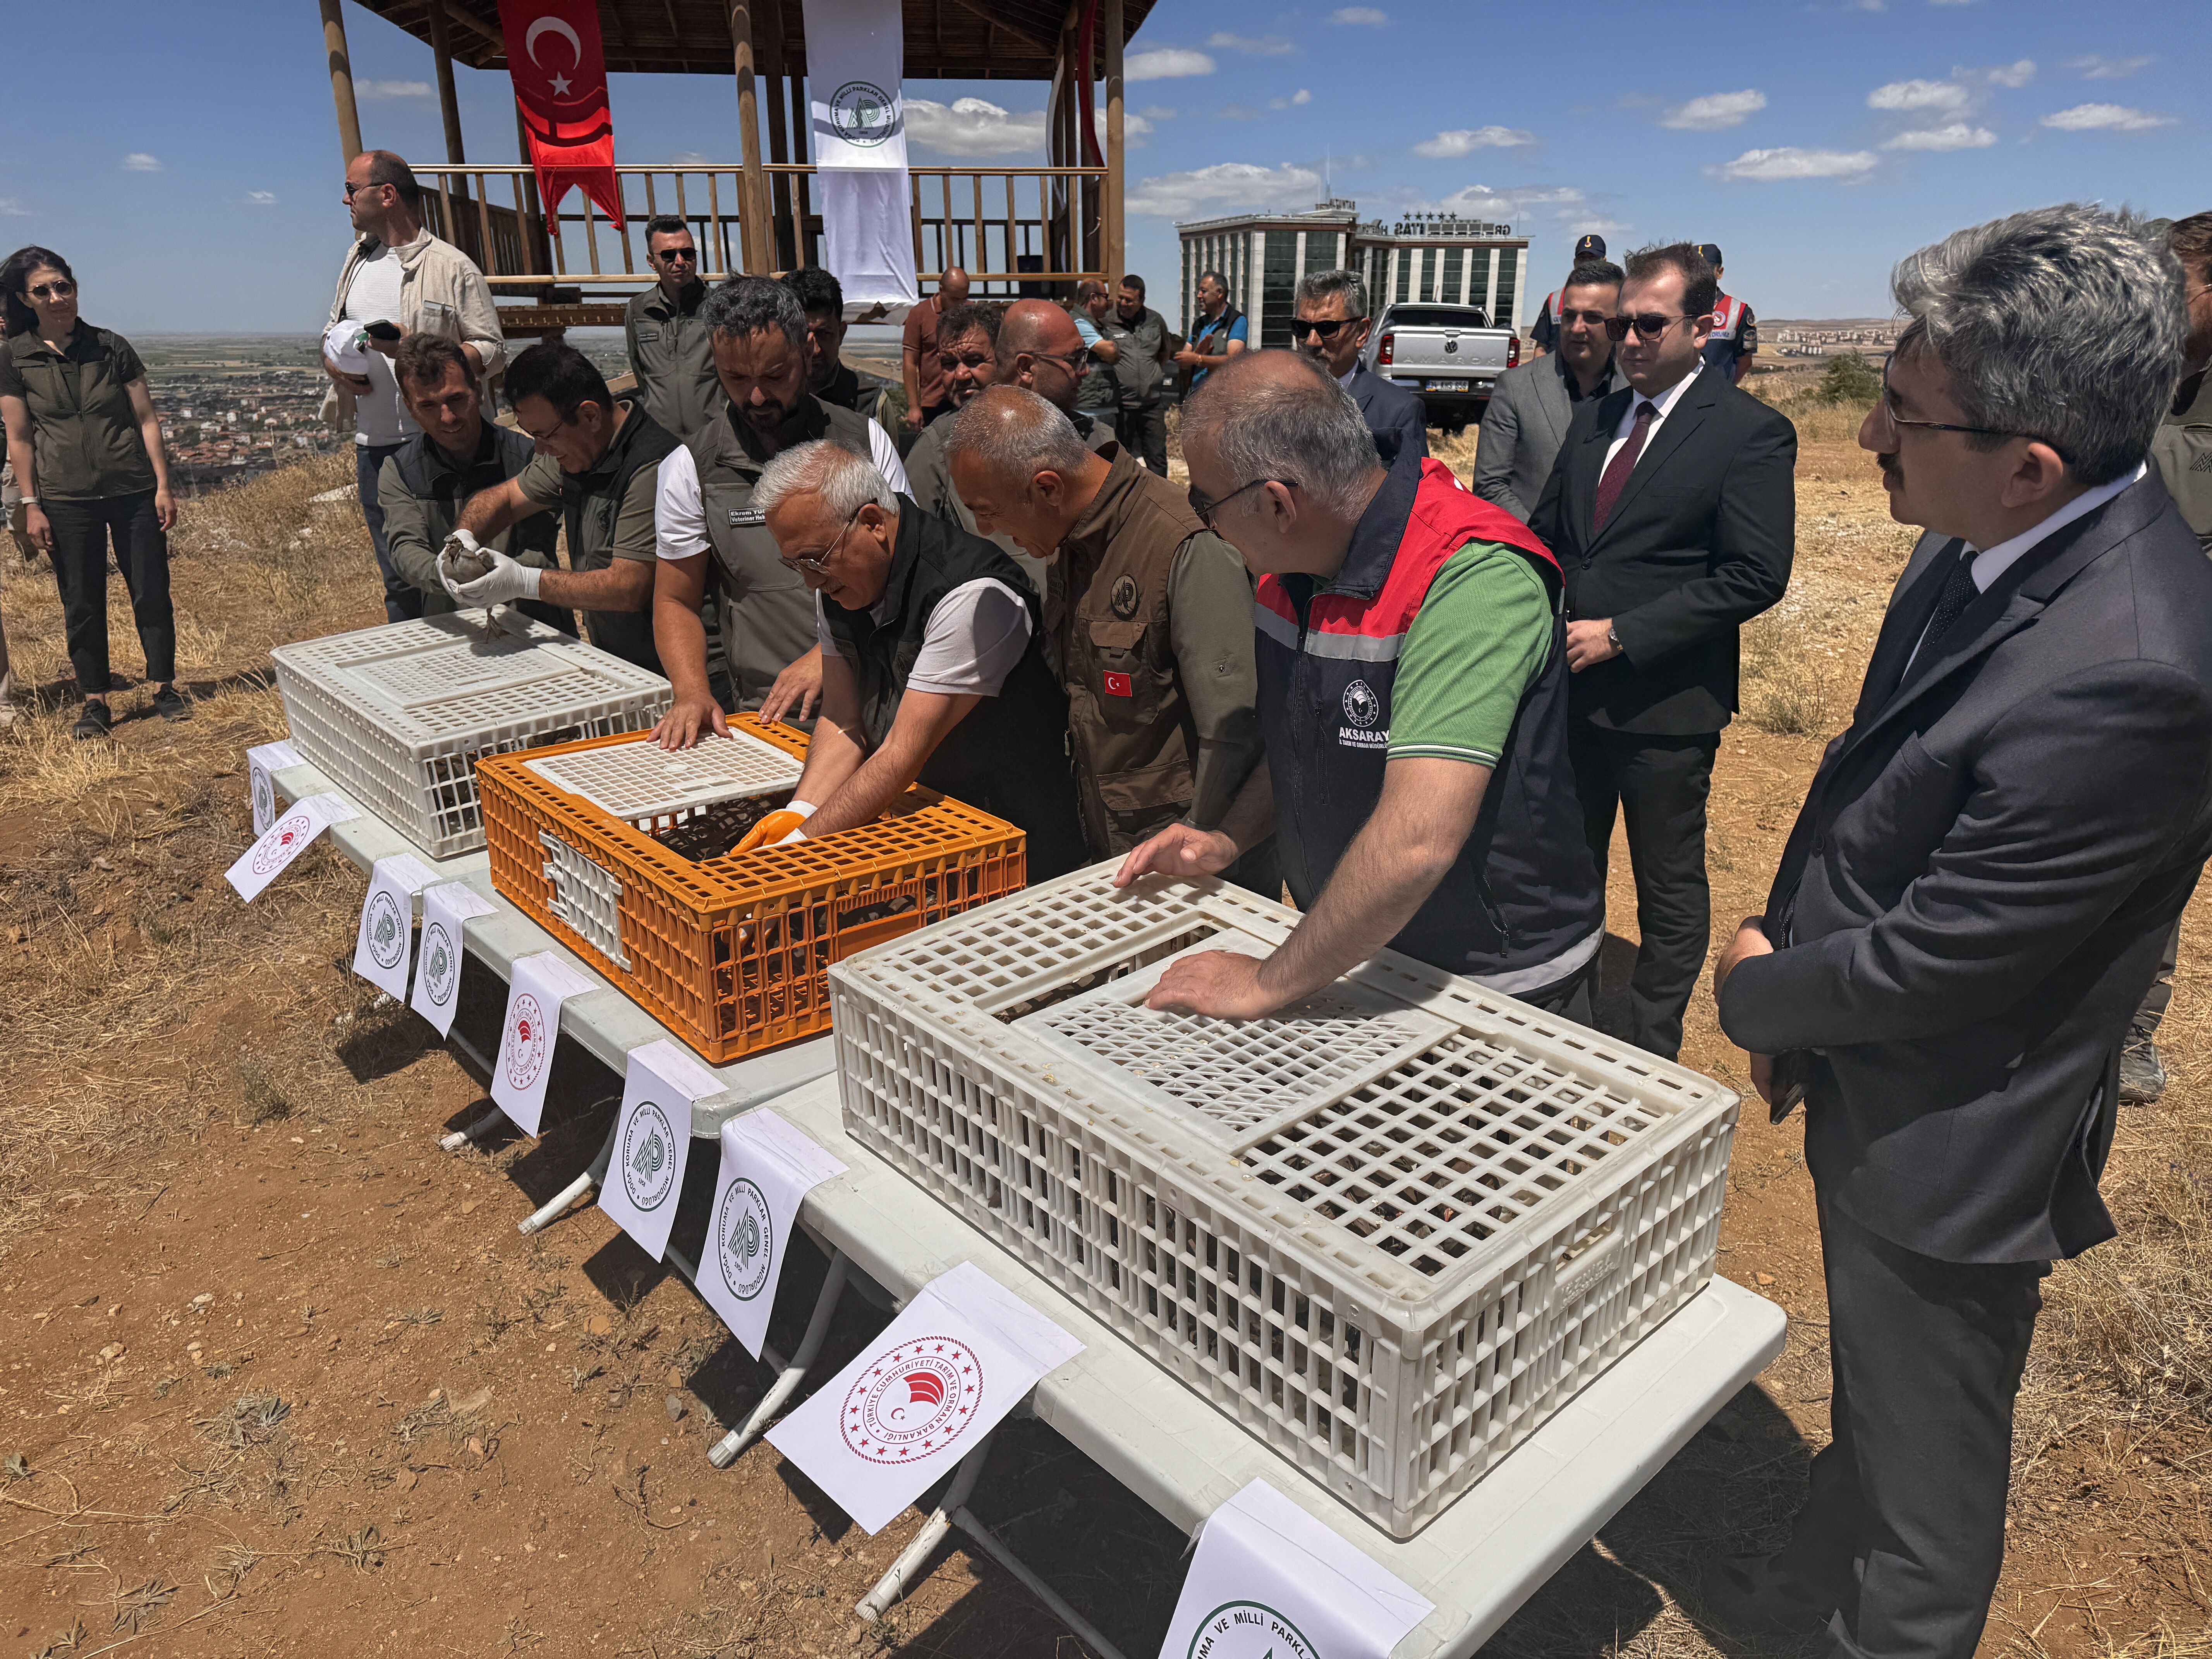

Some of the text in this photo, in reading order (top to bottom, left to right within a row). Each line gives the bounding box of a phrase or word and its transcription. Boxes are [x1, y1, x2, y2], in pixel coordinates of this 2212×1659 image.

[852, 86, 878, 97] PARKLAR
[878, 96, 890, 114] GENEL
[1403, 356, 1497, 366] AMAROK
[1339, 726, 1389, 742] AKSARAY
[627, 1171, 635, 1195] DOĞA
[633, 1116, 639, 1126] VE
[652, 1109, 669, 1138] PARKLAR
[723, 1252, 732, 1279] DOĞA
[728, 1192, 735, 1203] VE
[747, 1189, 766, 1221] PARKLAR
[867, 1359, 957, 1441] TÜRKİYE CUMHURİYETİ TARIM VE ORMAN BAKANLIĞI
[1214, 1618, 1230, 1634] VE
[1234, 1610, 1264, 1626] MİLLİ
